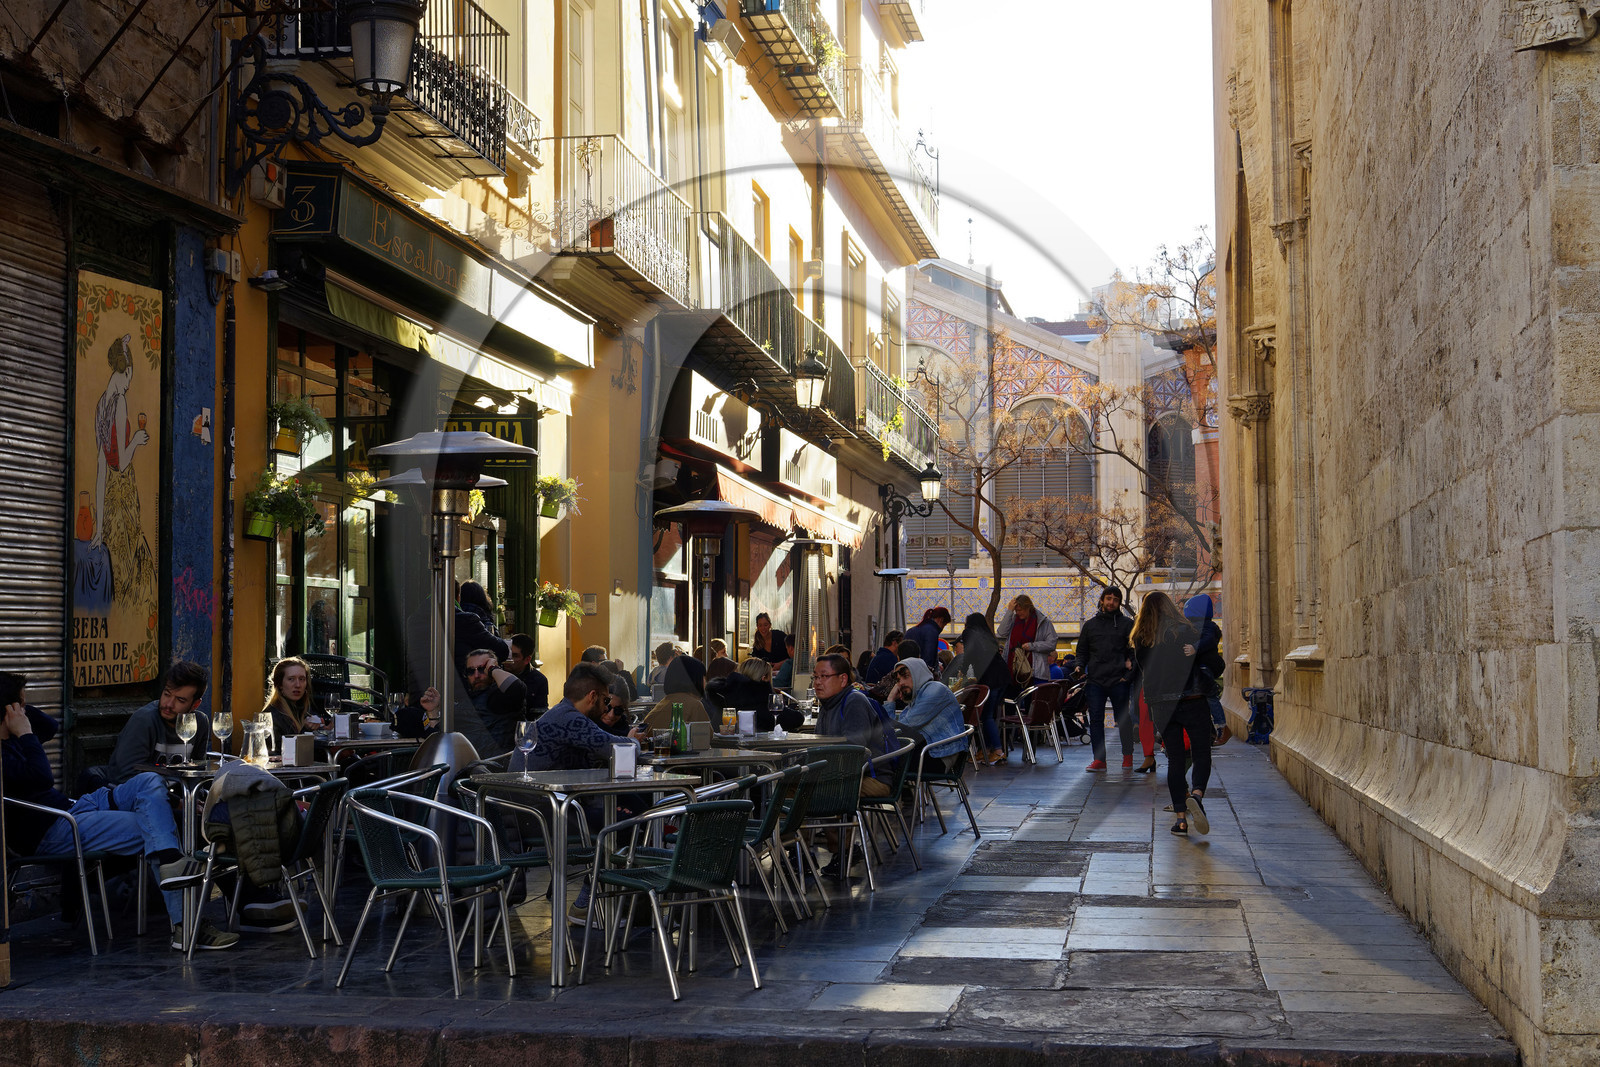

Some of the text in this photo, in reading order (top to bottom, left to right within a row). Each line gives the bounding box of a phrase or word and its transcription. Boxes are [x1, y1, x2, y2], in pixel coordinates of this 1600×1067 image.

[290, 185, 316, 223] 3
[72, 617, 108, 639] BEBA
[72, 642, 129, 663] AGUA DE
